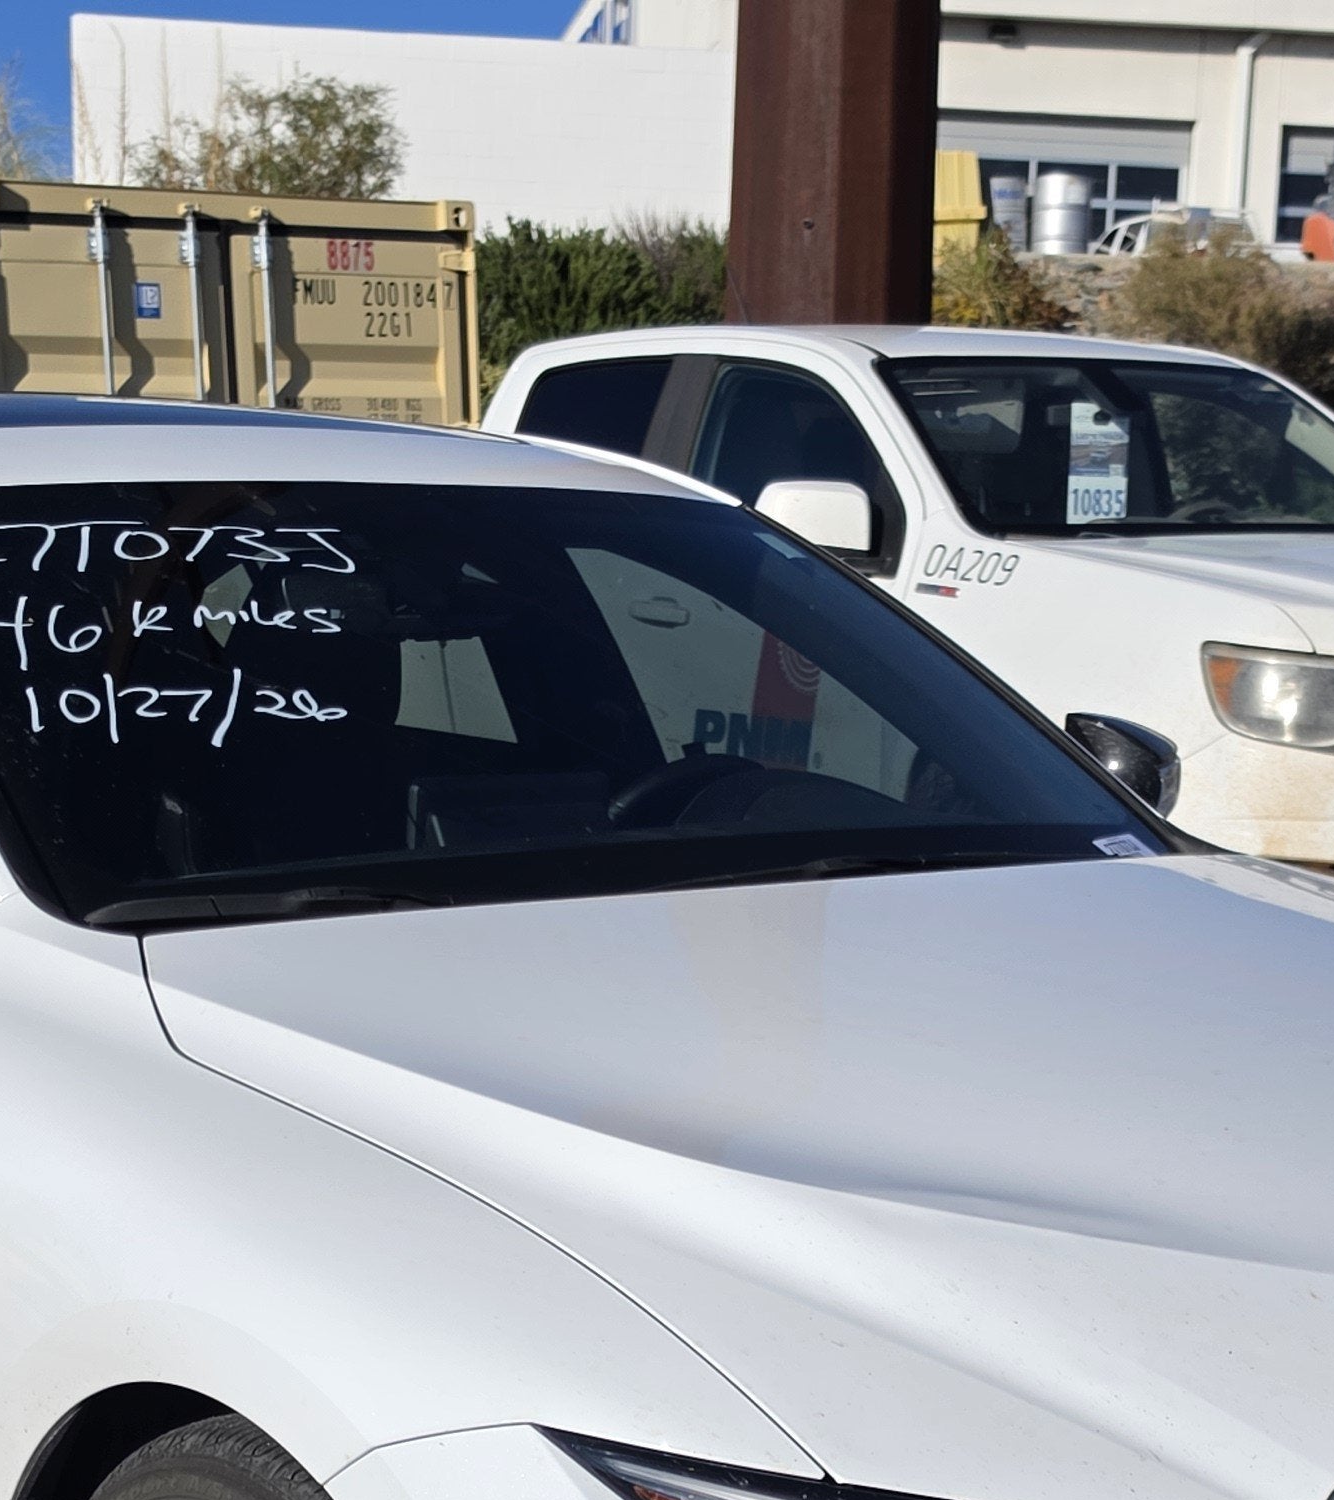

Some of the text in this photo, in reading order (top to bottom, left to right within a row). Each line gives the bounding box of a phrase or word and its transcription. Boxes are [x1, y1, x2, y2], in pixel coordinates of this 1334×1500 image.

[362, 281, 437, 308] 200184
[365, 311, 413, 338] 22G1
[1072, 488, 1124, 516] 10835
